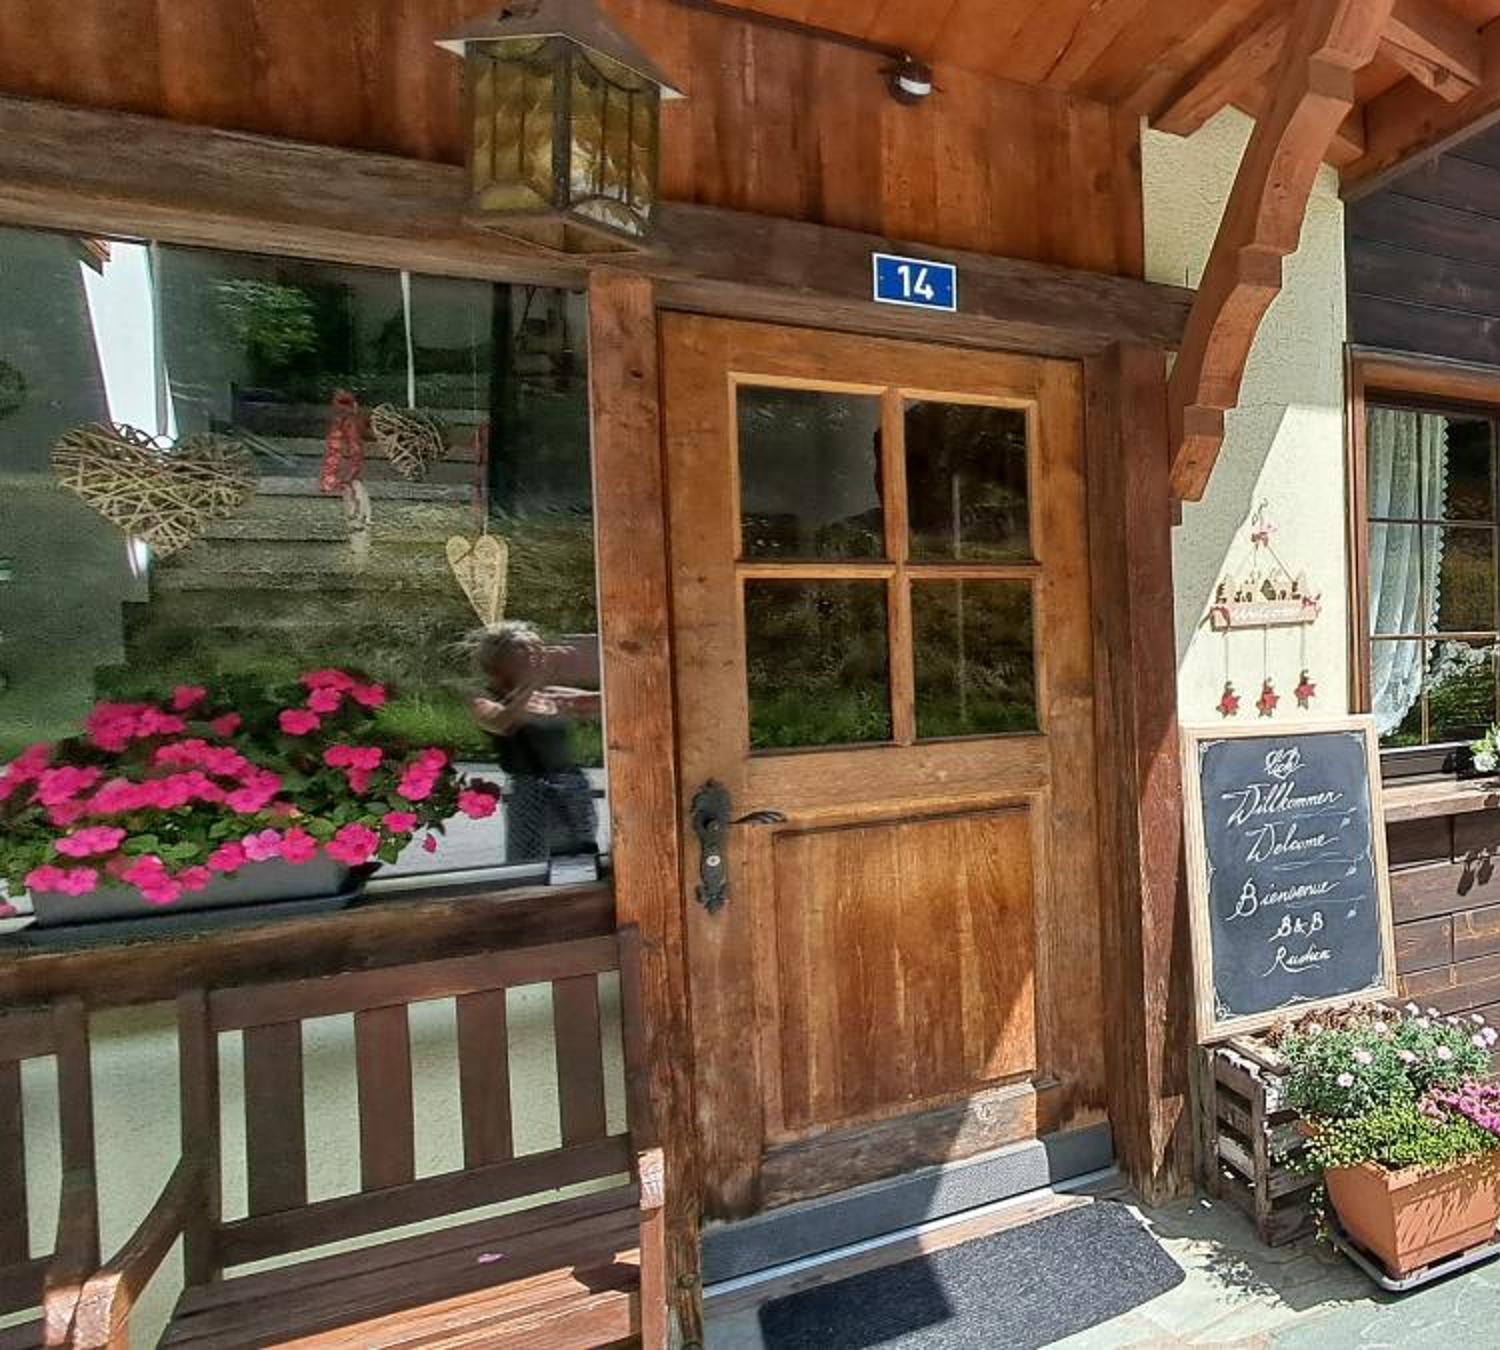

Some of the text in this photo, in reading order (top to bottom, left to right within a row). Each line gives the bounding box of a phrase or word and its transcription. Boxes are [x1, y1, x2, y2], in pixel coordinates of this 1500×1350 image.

[897, 265, 935, 300] 14
[1221, 781, 1343, 827] Willkommen
[1245, 822, 1339, 862] Welcome
[1225, 877, 1341, 921] Bienvenue
[1268, 911, 1324, 942] B&B
